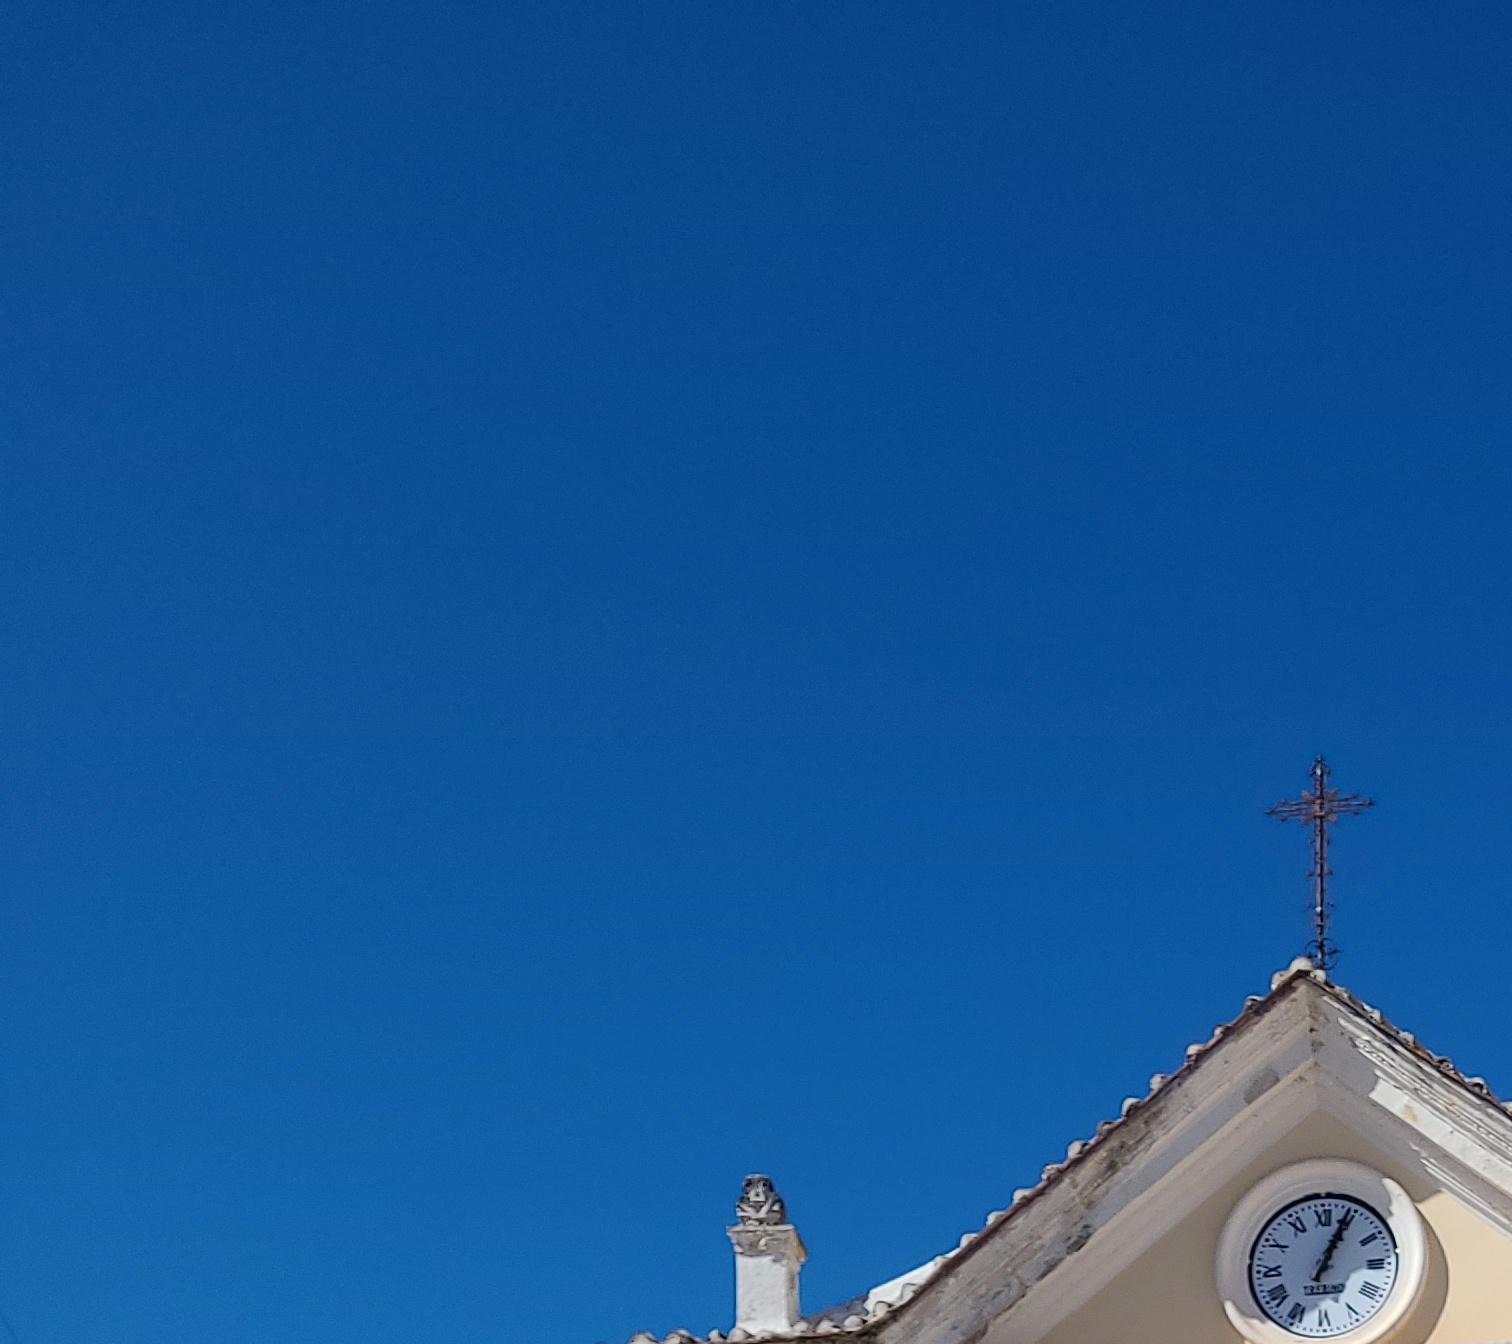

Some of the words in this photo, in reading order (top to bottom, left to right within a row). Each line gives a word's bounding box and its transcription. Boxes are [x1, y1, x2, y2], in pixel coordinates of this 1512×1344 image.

[1358, 1231, 1379, 1247] II
[1365, 1257, 1386, 1271] III
[1357, 1280, 1381, 1301] IIII
